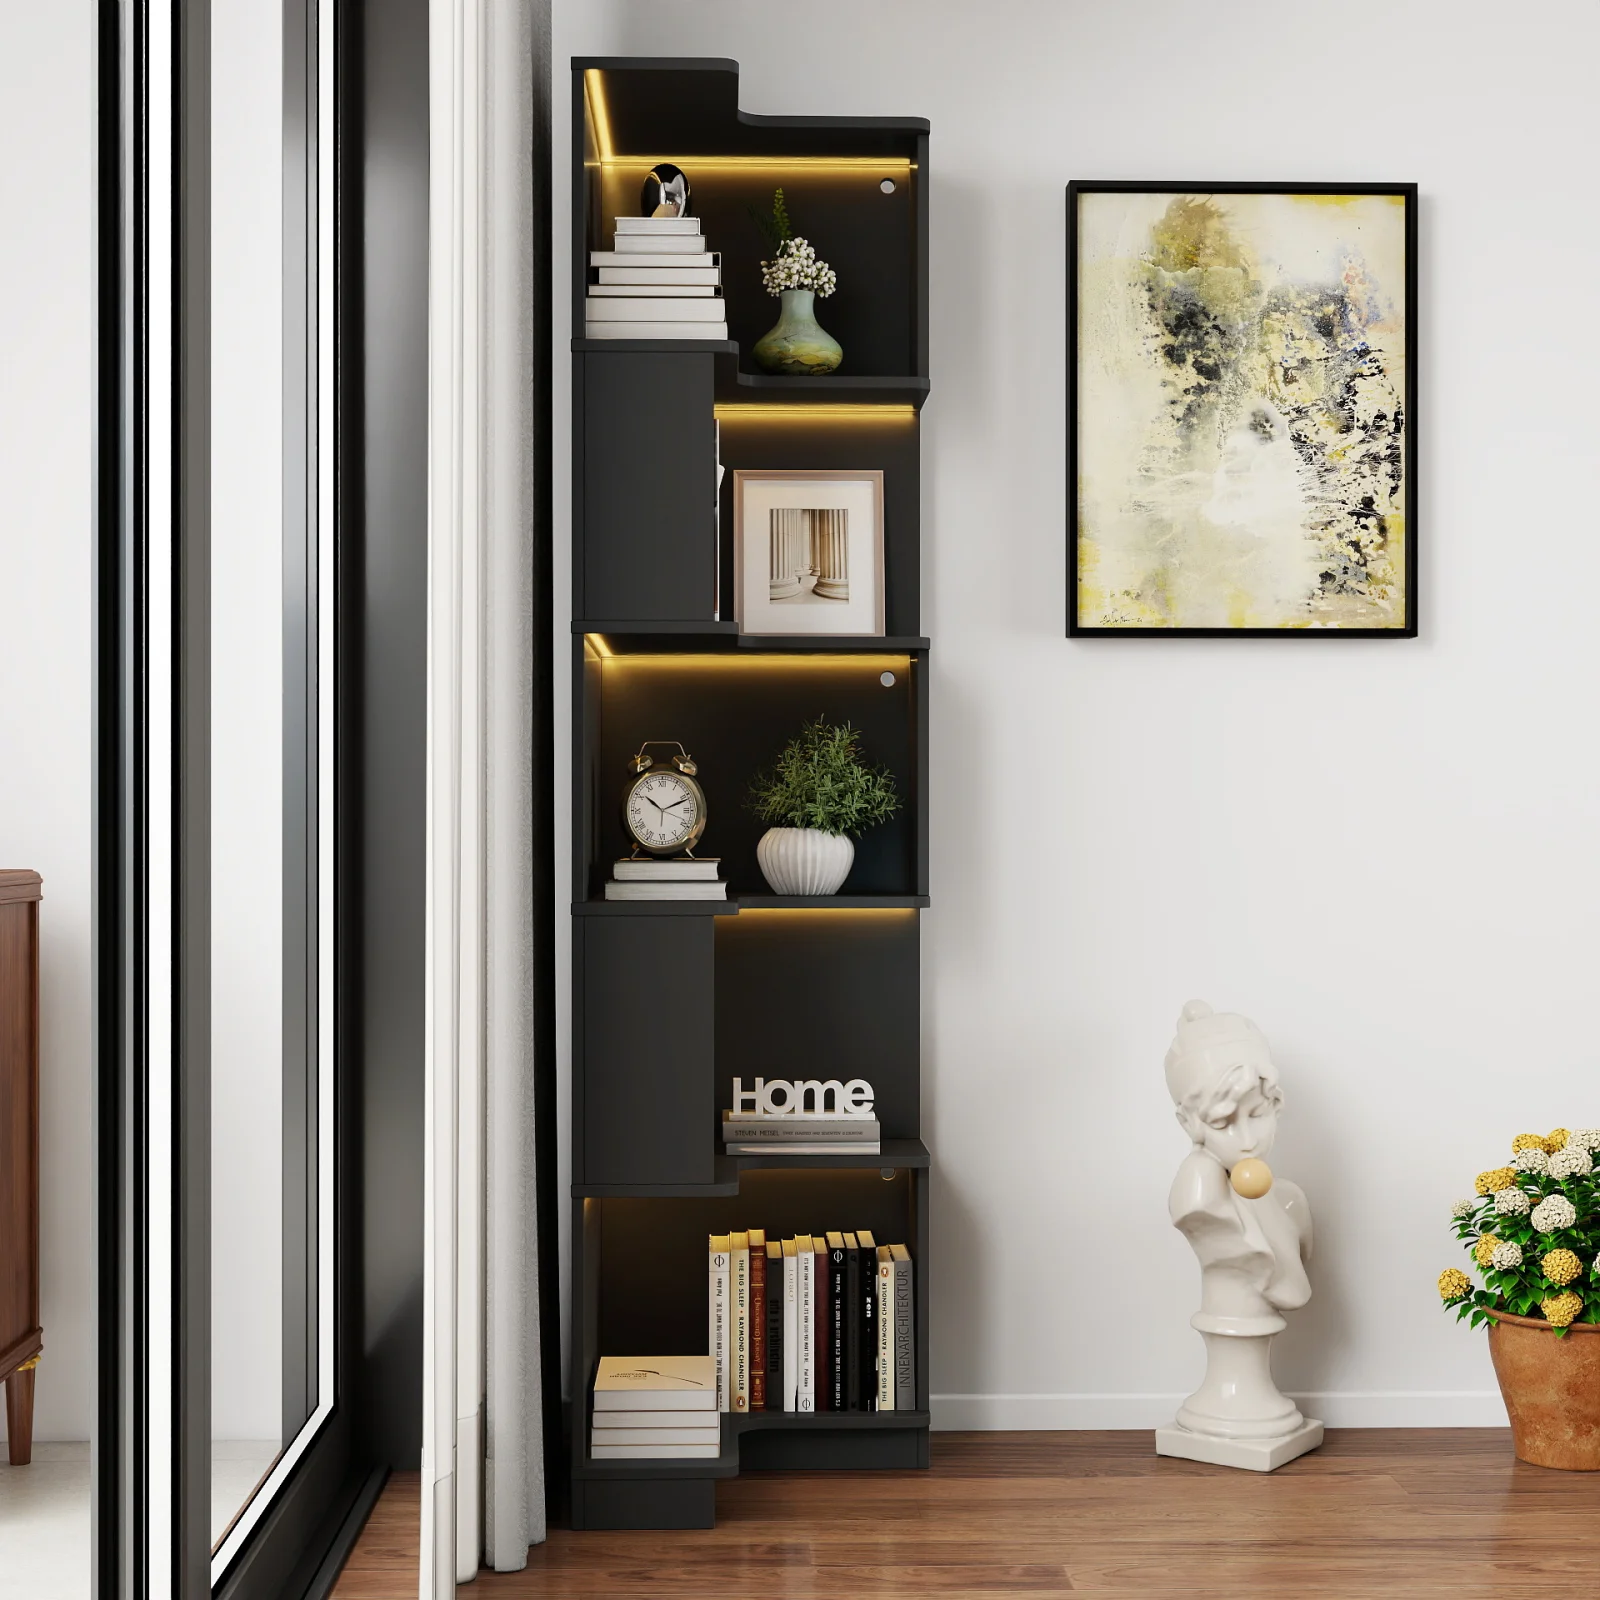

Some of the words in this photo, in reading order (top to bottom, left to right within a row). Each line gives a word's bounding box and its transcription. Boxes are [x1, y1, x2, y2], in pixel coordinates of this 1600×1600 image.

[646, 784, 654, 792] XI
[638, 818, 646, 829] VIII
[646, 830, 654, 838] VII
[732, 1077, 875, 1114] Home
[897, 1270, 910, 1388] INNENARCHITEKTUR
